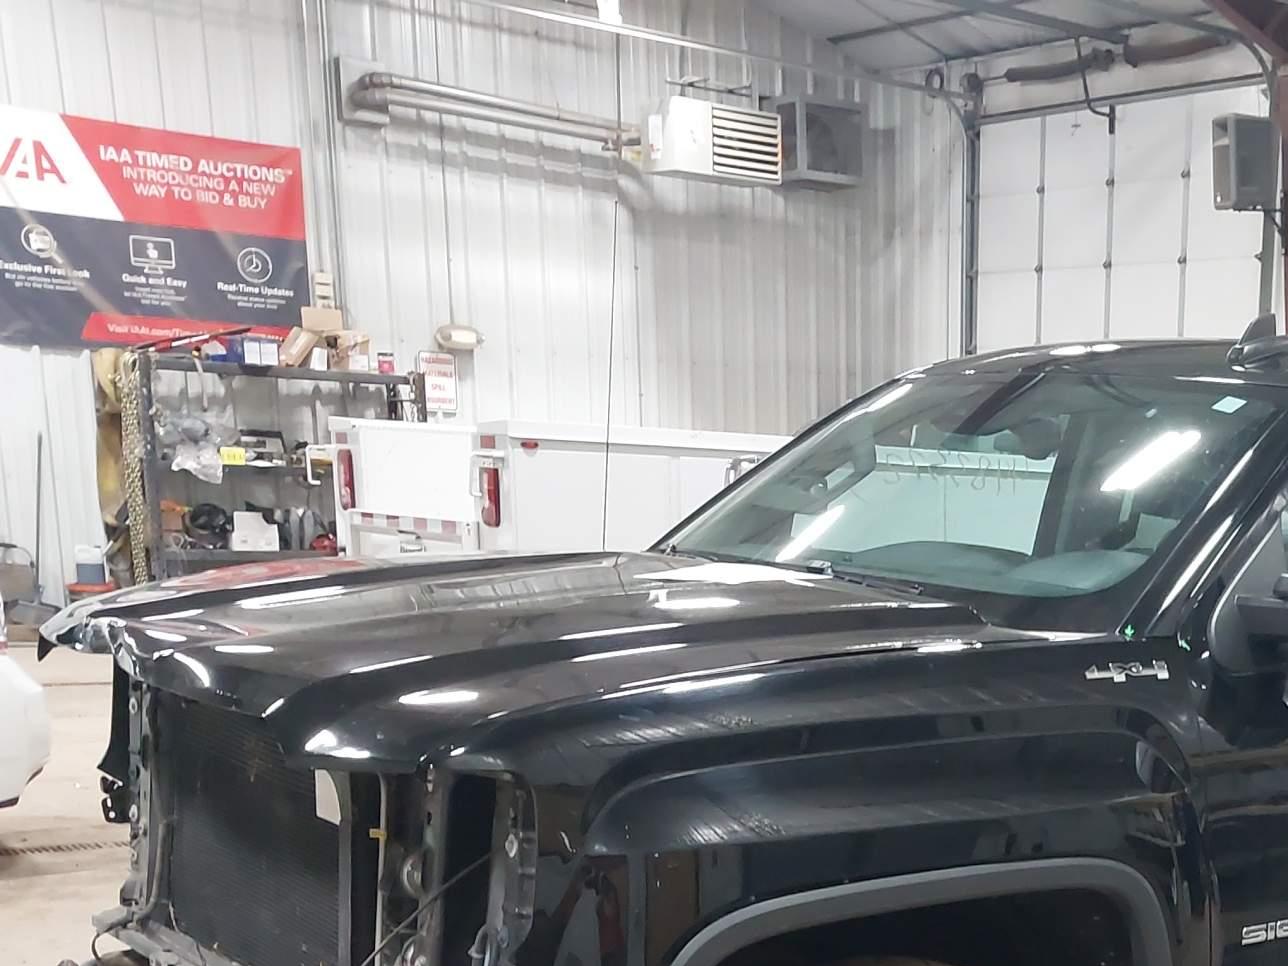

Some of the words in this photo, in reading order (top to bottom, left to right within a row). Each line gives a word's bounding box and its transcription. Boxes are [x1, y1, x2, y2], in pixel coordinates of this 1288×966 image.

[100, 145, 132, 164] IAA
[134, 150, 193, 172] TIMED
[123, 166, 225, 191] INTRODUCING
[228, 180, 240, 192] A
[242, 181, 276, 197] NEW
[133, 183, 168, 199] WAY
[171, 186, 193, 201] TO
[196, 190, 219, 205] BID
[223, 193, 235, 206] &
[238, 195, 268, 209] BUY
[121, 273, 147, 285] Quick
[148, 276, 165, 286] and
[166, 277, 188, 289] Easy
[217, 281, 260, 294] Real-Time
[260, 285, 294, 298] Updates
